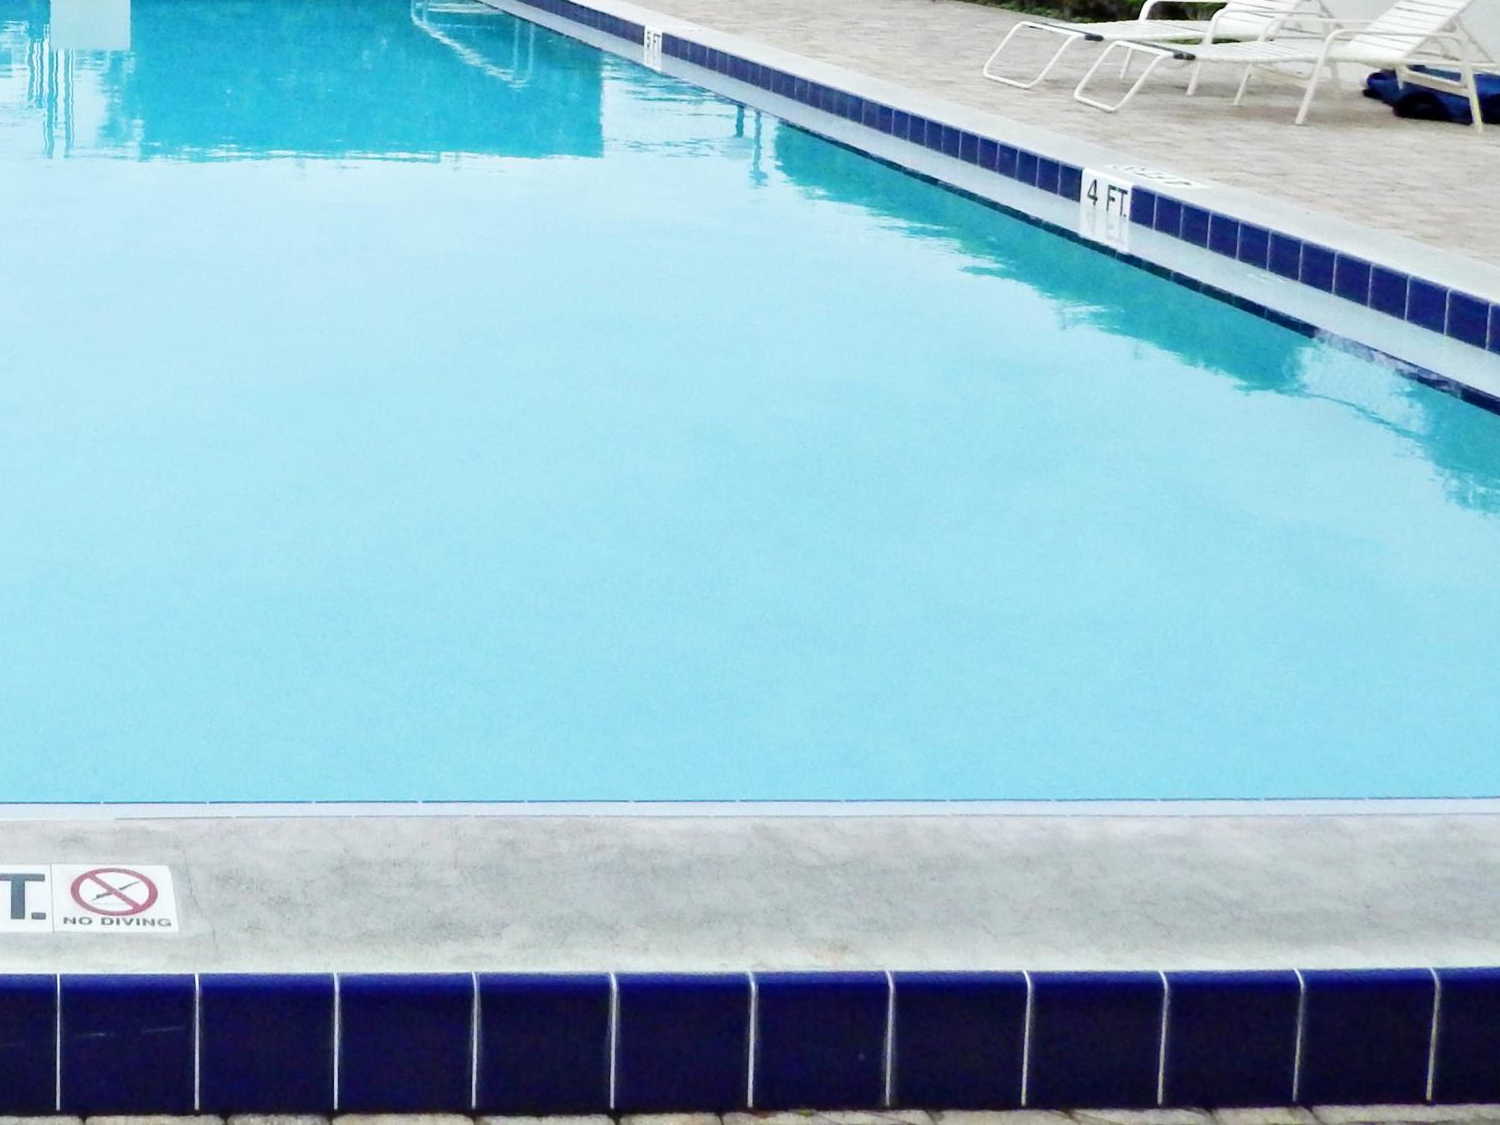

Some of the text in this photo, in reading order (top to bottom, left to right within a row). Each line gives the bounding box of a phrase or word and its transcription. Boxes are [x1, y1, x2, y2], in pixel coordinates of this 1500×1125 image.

[1087, 179, 1128, 217] 4 FT.
[63, 917, 173, 927] NO DIVING
